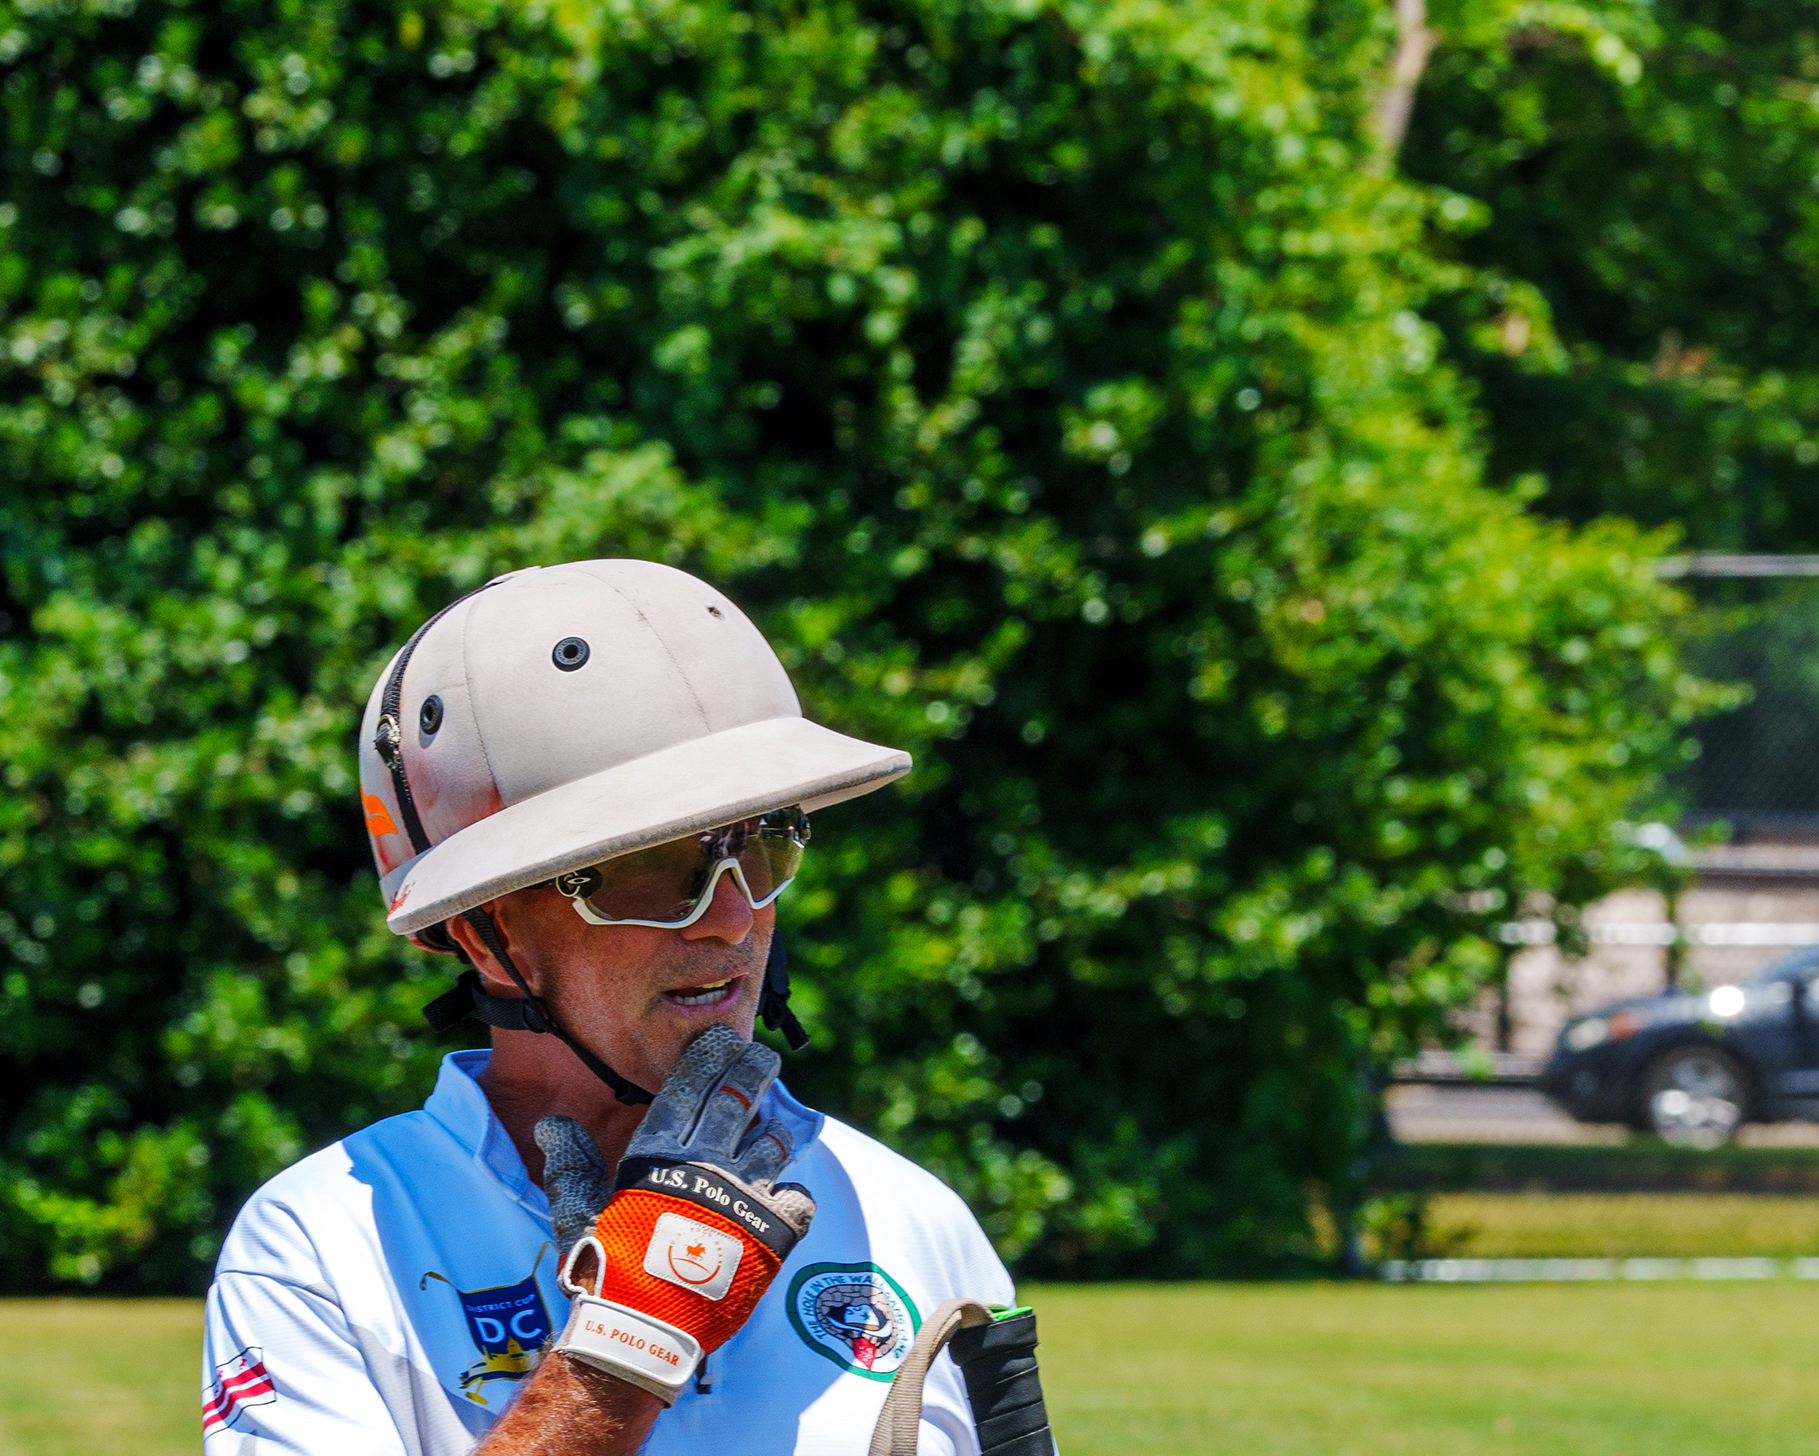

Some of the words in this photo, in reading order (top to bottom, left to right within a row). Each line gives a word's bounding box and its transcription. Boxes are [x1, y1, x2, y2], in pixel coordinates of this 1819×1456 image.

[650, 1167, 688, 1189] U.S.
[692, 1176, 730, 1206] Polo
[733, 1200, 770, 1233] Gear
[809, 1280, 824, 1293] IN
[822, 1275, 846, 1286] THE
[514, 1293, 536, 1307] CUP
[802, 1290, 819, 1317] HOLE
[473, 1309, 543, 1344] DC
[807, 1320, 828, 1340] THE
[585, 1320, 607, 1336] U.S.
[610, 1328, 646, 1350] POLO
[649, 1344, 680, 1366] GEAR
